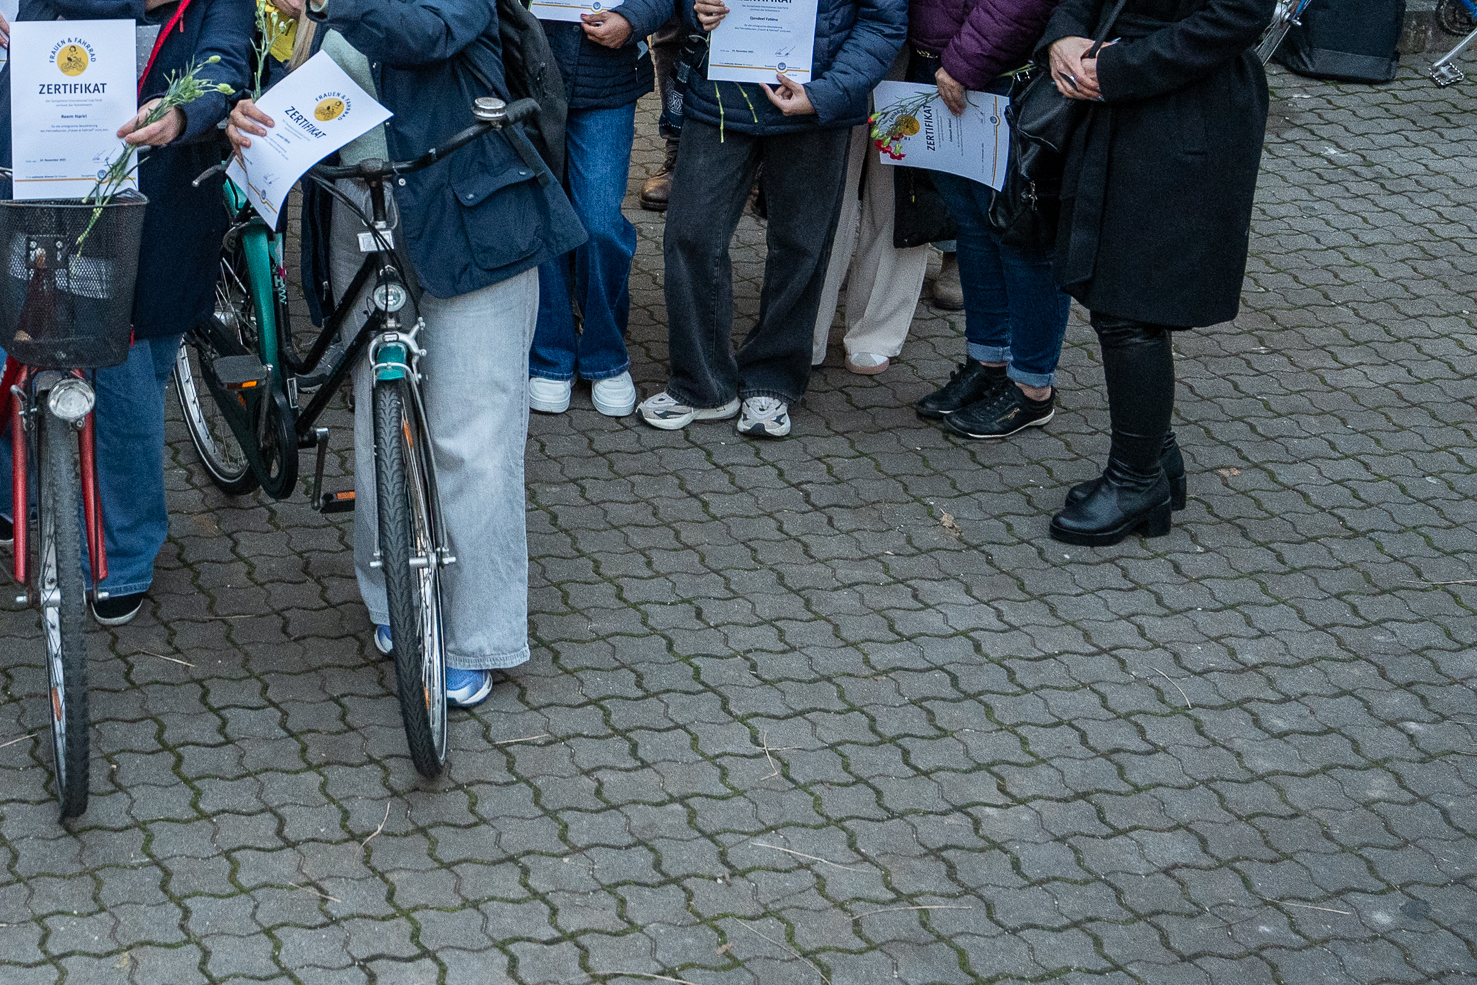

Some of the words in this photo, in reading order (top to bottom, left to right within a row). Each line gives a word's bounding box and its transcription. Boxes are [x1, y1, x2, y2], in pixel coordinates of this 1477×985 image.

[49, 39, 66, 63] FRAUEN
[74, 37, 96, 63] FAHRRAD
[39, 83, 107, 94] ZERTIFIKAT
[315, 92, 341, 102] FRAUEN
[285, 106, 326, 139] ZERTIFIKAT
[923, 104, 935, 151] ZERTIFIKAT
